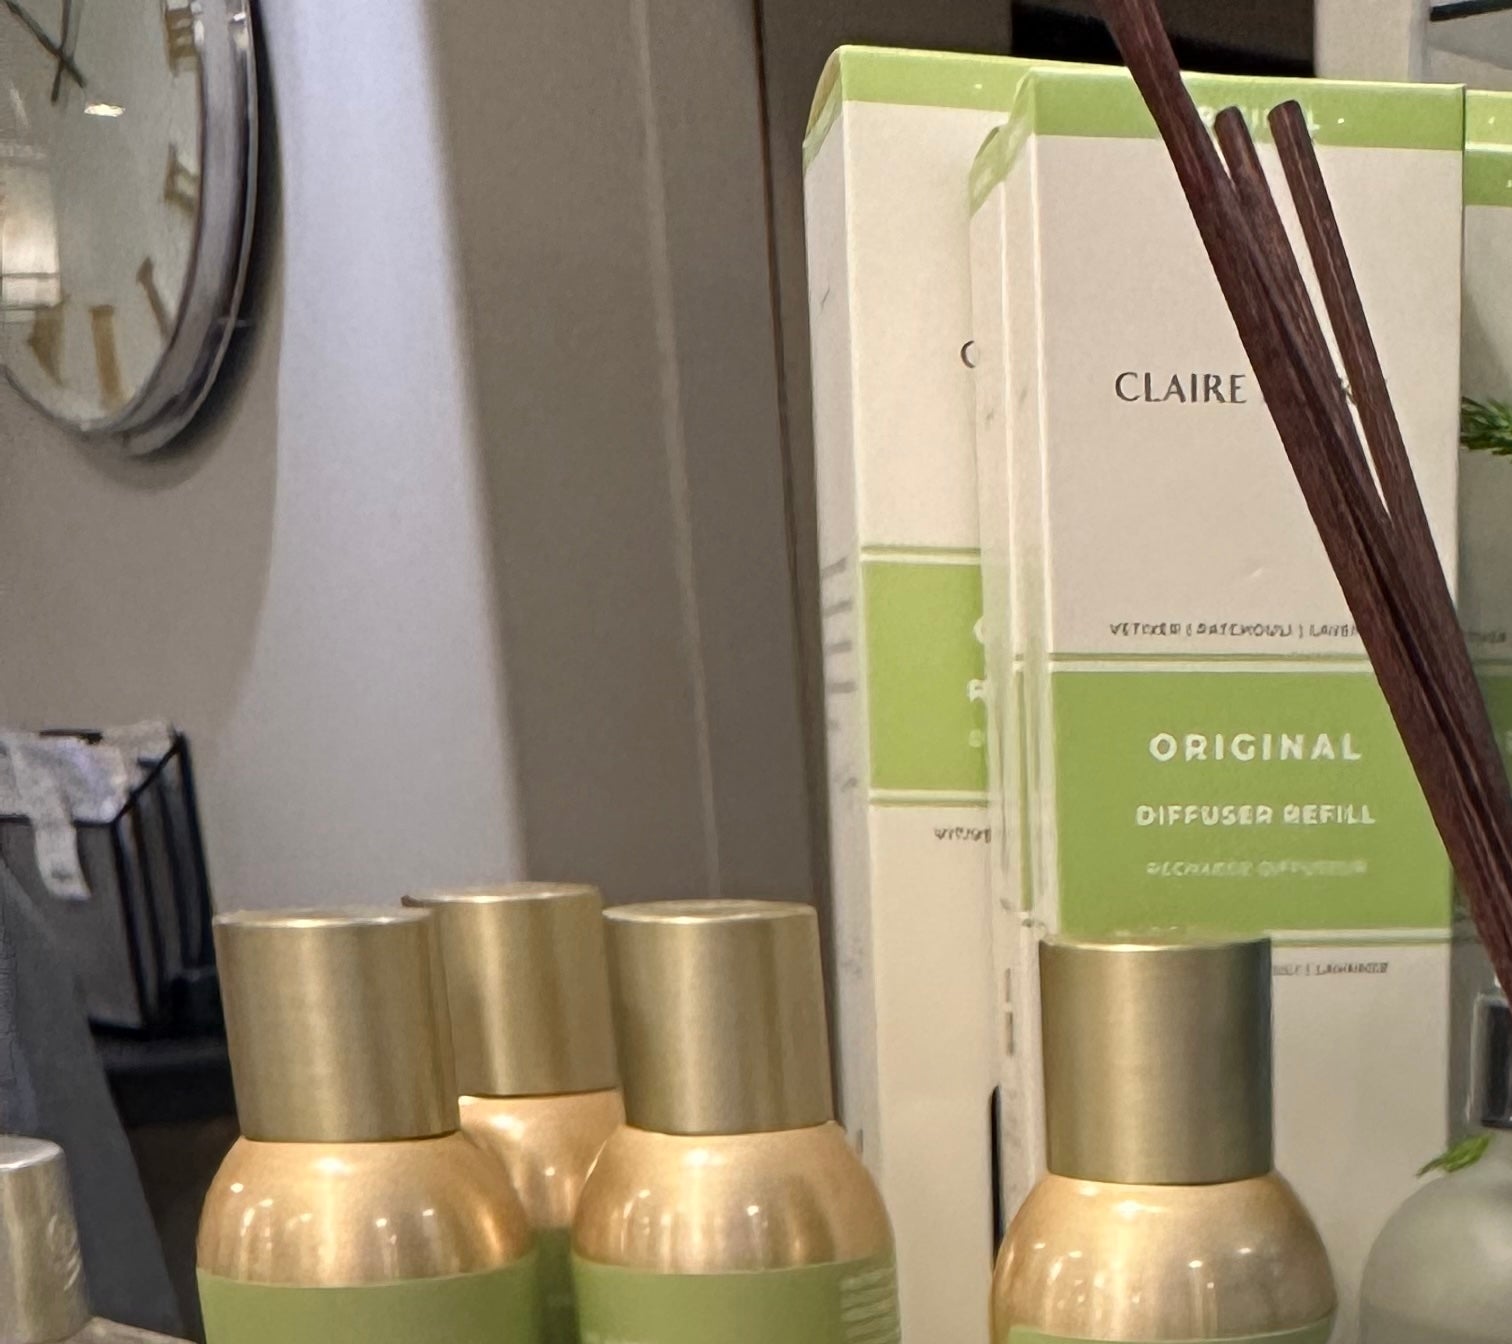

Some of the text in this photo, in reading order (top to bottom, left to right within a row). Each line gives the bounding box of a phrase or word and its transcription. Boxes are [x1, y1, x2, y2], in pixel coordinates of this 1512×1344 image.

[1114, 371, 1248, 404] CLAIRE
[1149, 732, 1362, 762] ORIGINAL
[1135, 803, 1376, 826] DIFFUSER REFILL
